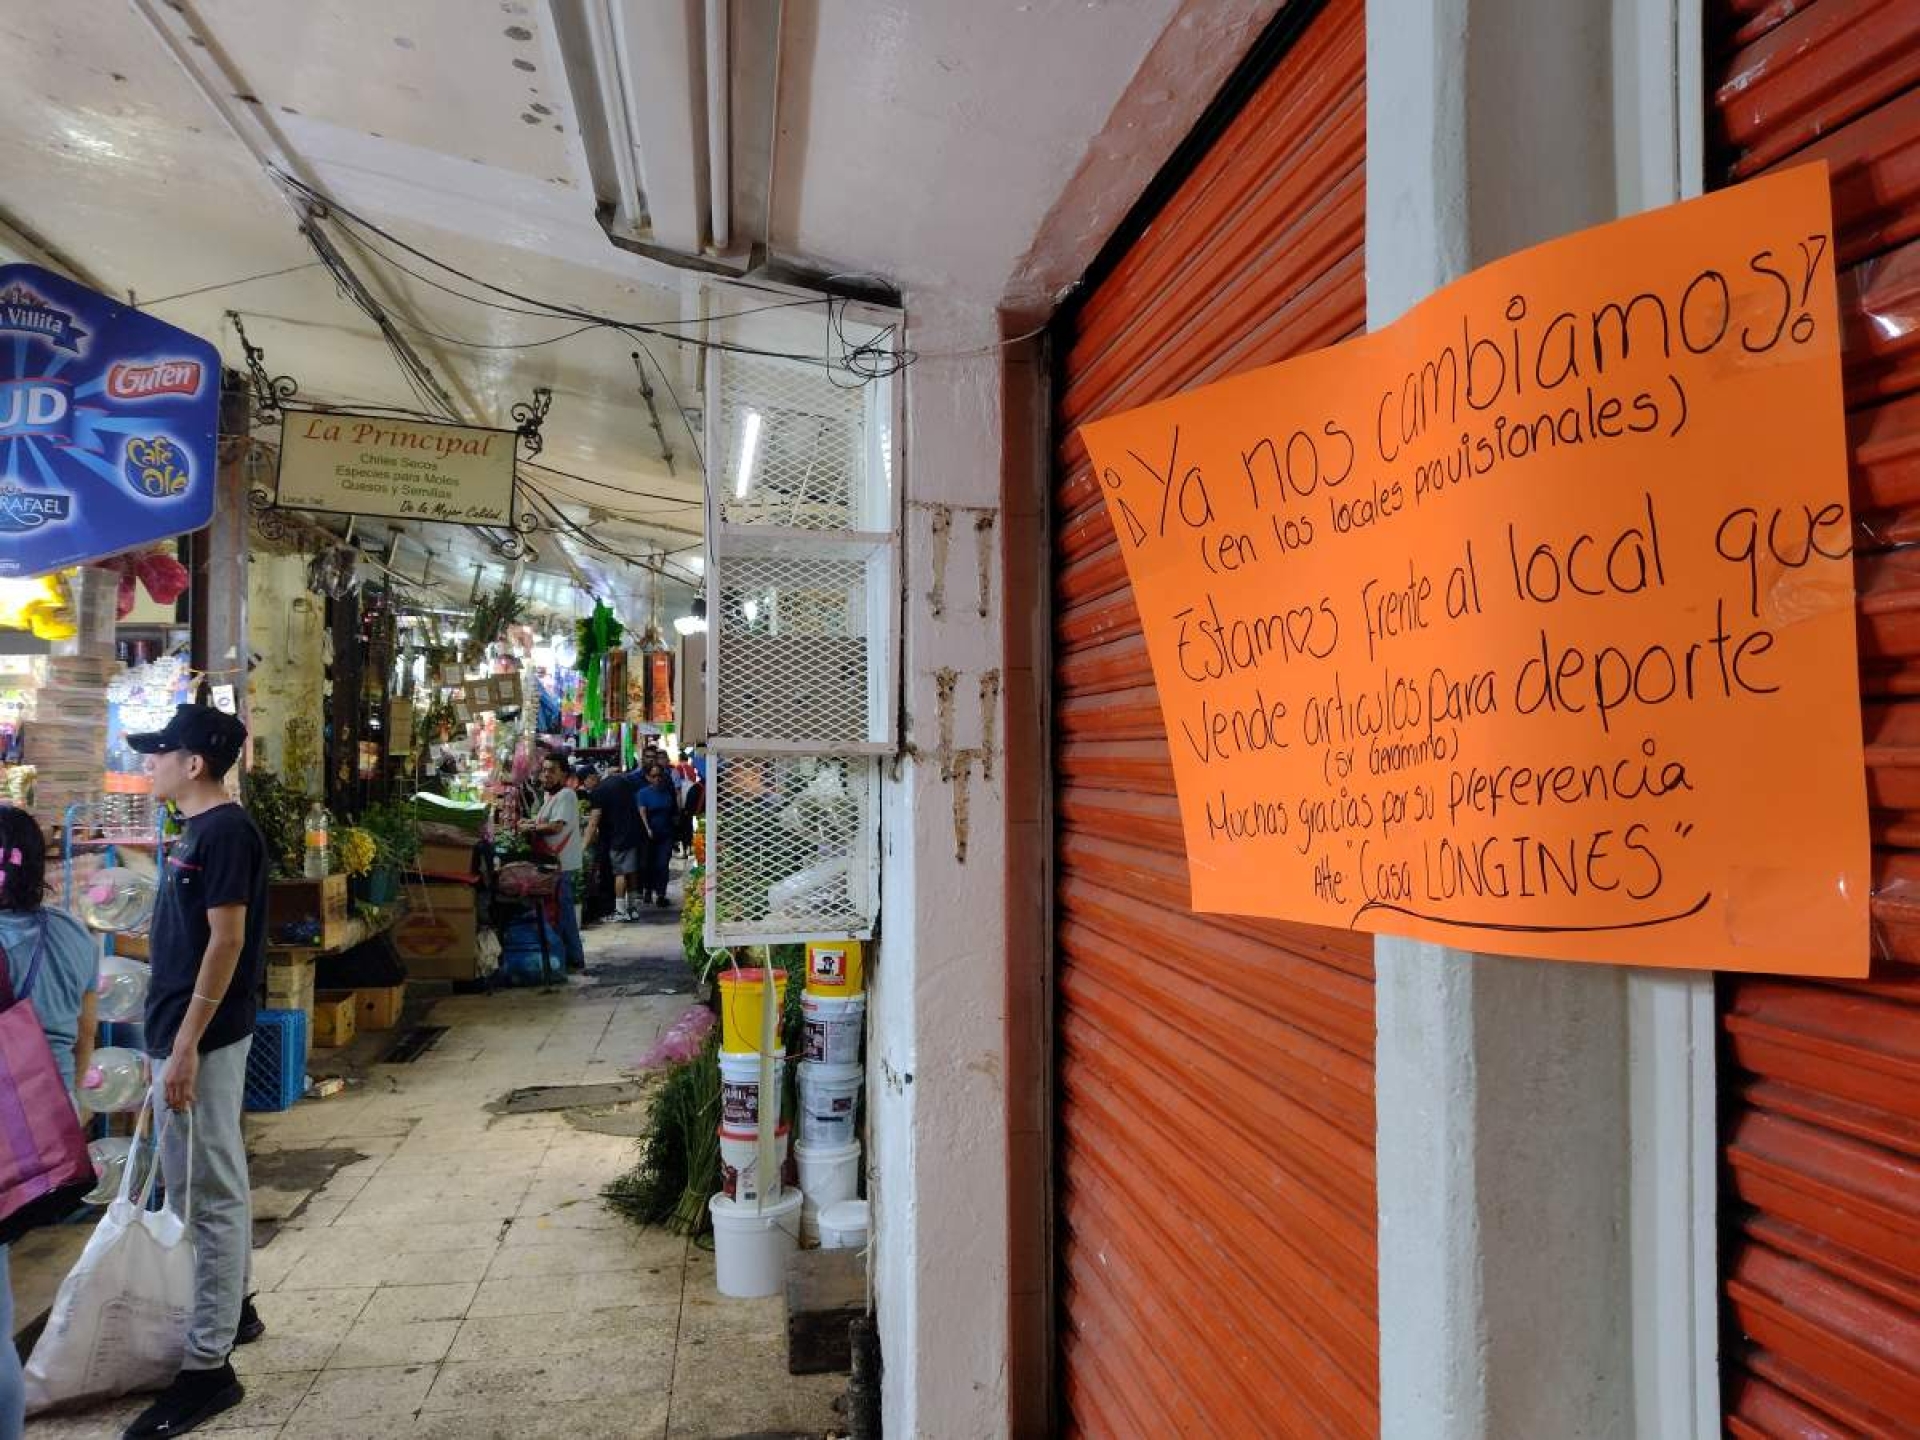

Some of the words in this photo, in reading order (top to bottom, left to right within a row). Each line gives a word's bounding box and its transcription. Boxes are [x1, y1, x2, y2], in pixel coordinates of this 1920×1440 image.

[8, 306, 63, 333] Villita
[114, 361, 192, 394] Guten
[127, 435, 173, 468] Café
[302, 418, 341, 441] La
[352, 423, 499, 460] Principal
[335, 465, 391, 479] Especies
[393, 472, 420, 483] para
[424, 473, 460, 487] Moles
[360, 452, 397, 466] Chiles
[401, 458, 438, 471] Secos
[1241, 421, 1354, 510] nos
[143, 465, 188, 496] Olé
[341, 479, 388, 494] Quesos
[402, 484, 452, 499] Semillas
[1273, 513, 1313, 555] los
[1331, 479, 1403, 535] locales
[1445, 538, 1483, 620] al
[1508, 492, 1664, 602] local
[1716, 502, 1855, 617] que
[1516, 597, 1780, 733] deporte
[1206, 790, 1289, 842] Muchas
[1299, 785, 1374, 856] gracias
[1381, 790, 1409, 839] por
[1413, 785, 1435, 822] su
[1448, 737, 1694, 826] preferencia
